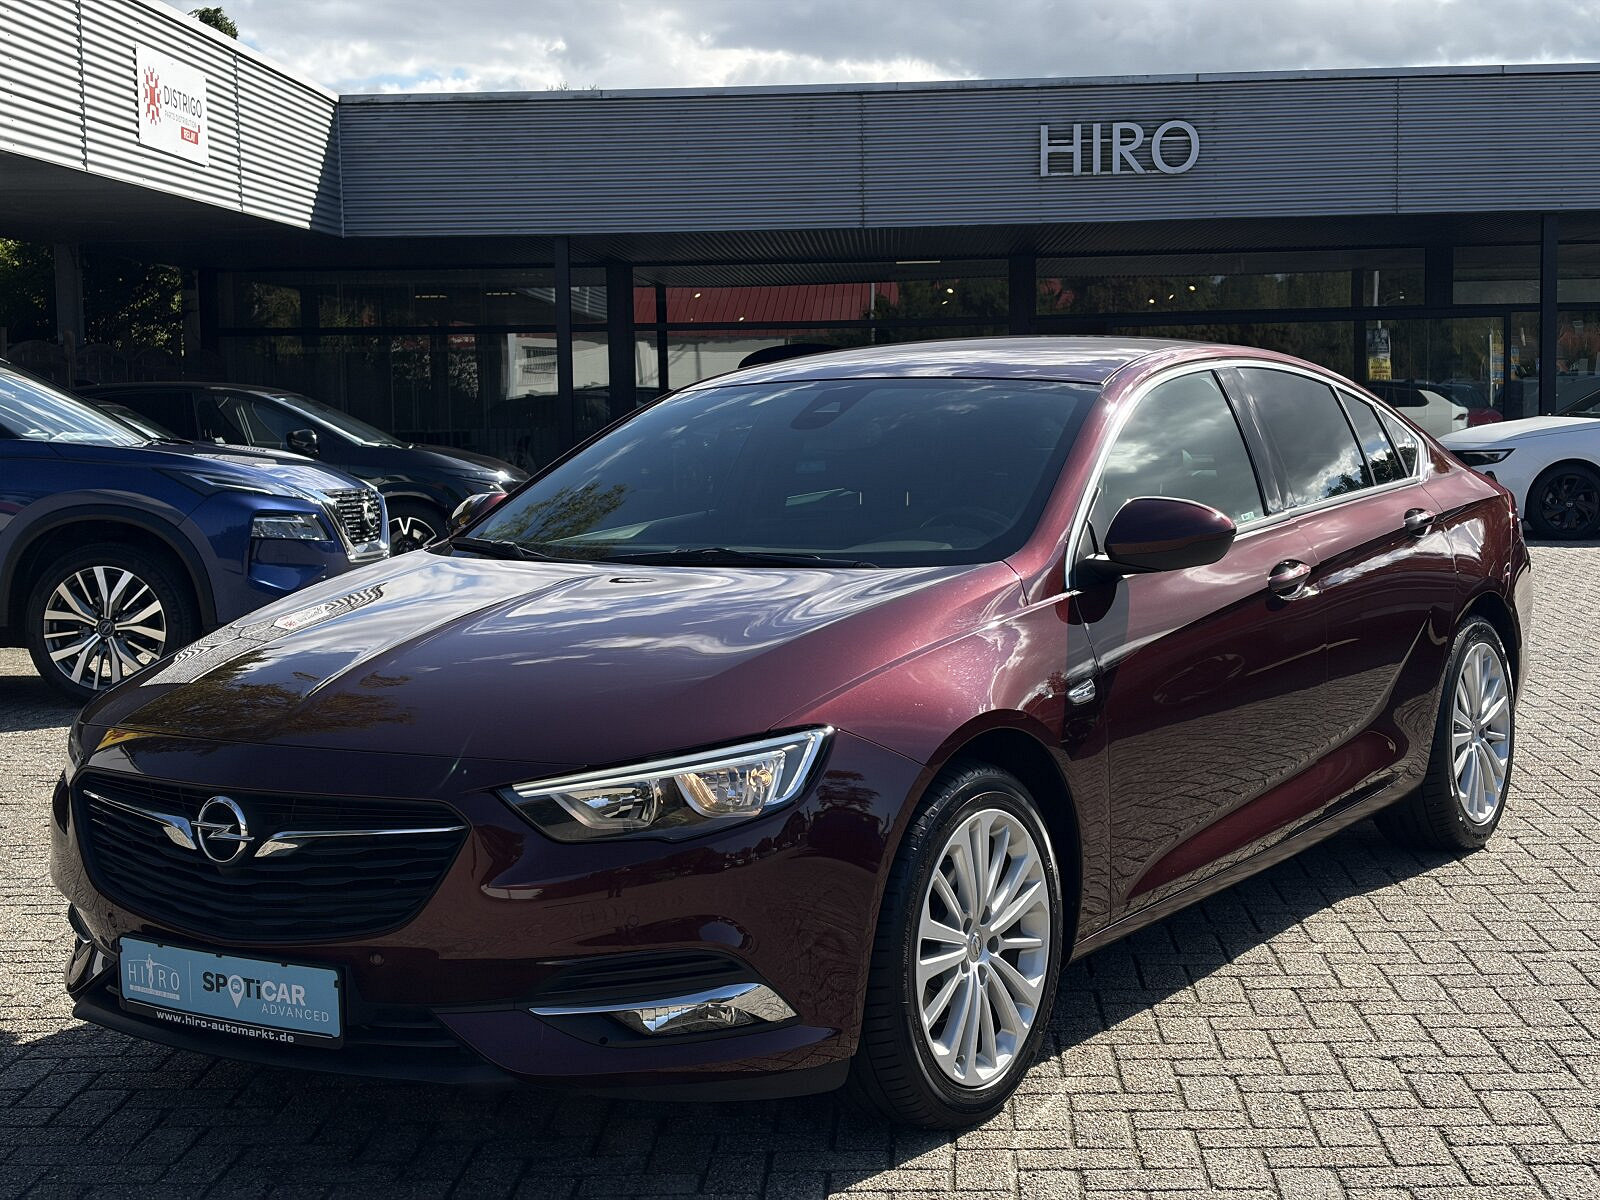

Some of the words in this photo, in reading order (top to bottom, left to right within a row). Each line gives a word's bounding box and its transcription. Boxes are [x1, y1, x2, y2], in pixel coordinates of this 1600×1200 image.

[164, 85, 203, 118] DISTRIGO
[1040, 120, 1200, 176] HIRO
[156, 1011, 295, 1043] www.hiro-automarkt.de
[261, 1003, 329, 1022] ADVANCED
